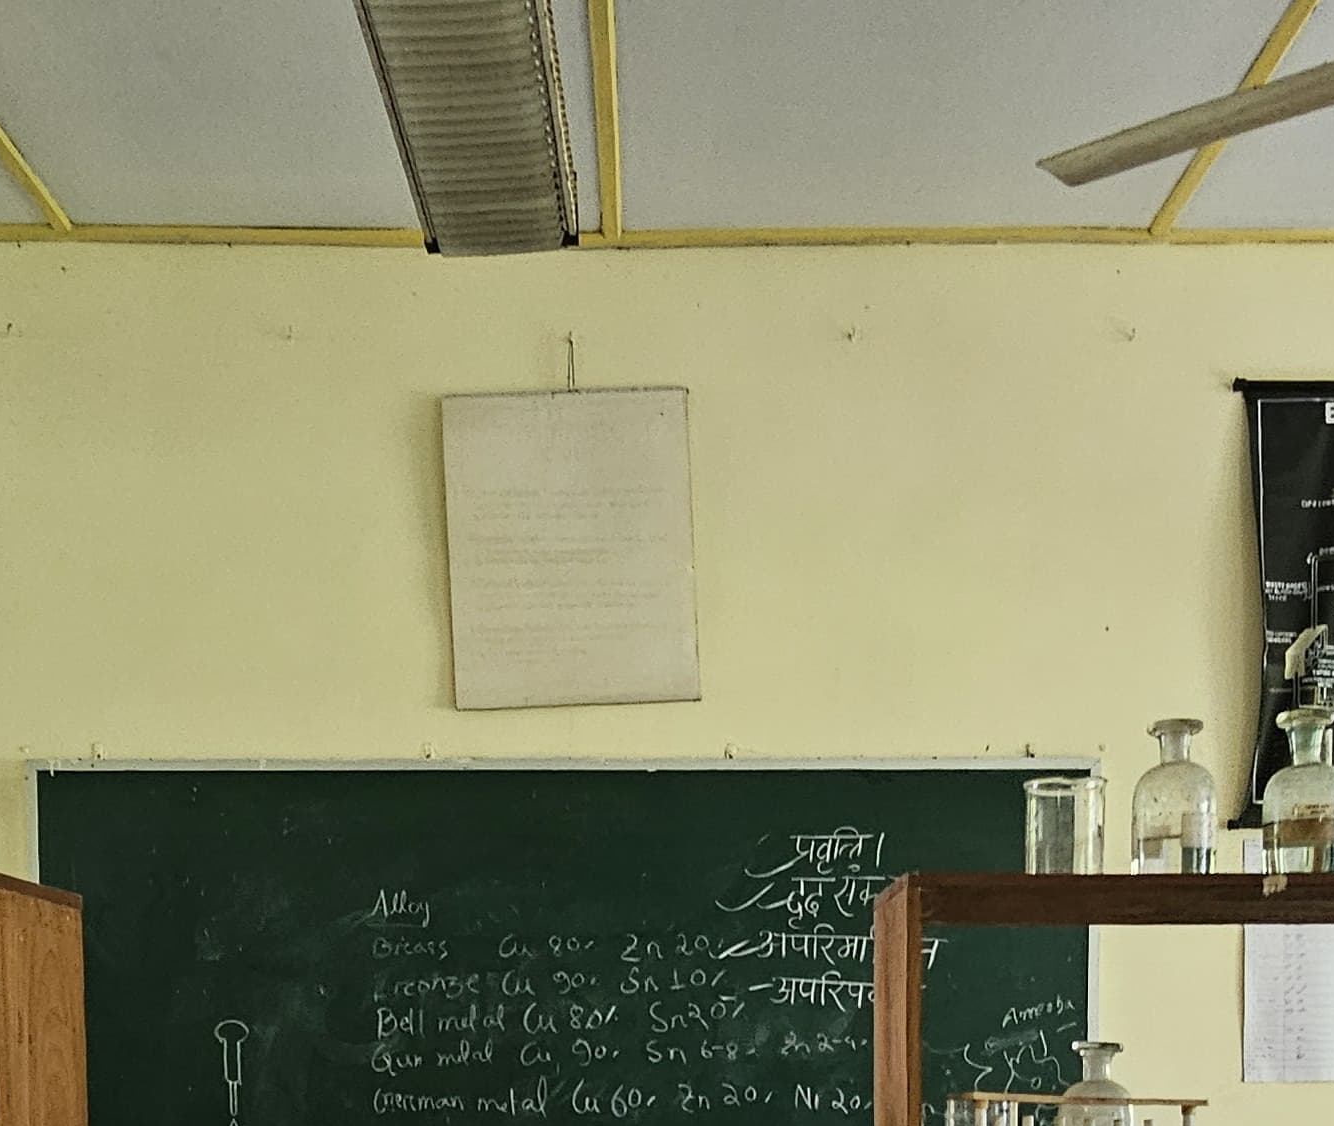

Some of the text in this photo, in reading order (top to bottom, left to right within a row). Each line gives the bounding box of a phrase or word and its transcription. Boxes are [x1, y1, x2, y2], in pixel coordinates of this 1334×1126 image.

[370, 888, 430, 928] Alloy
[499, 933, 534, 957] Cu
[621, 933, 664, 962] Zn
[502, 969, 536, 996] Cu
[620, 966, 659, 994] Sn
[377, 1007, 425, 1040] Bell
[438, 1003, 506, 1033] metal
[523, 1002, 559, 1034] Cu
[520, 1041, 552, 1067] Cu
[646, 1040, 687, 1064] Sn
[572, 1078, 601, 1114] Cu
